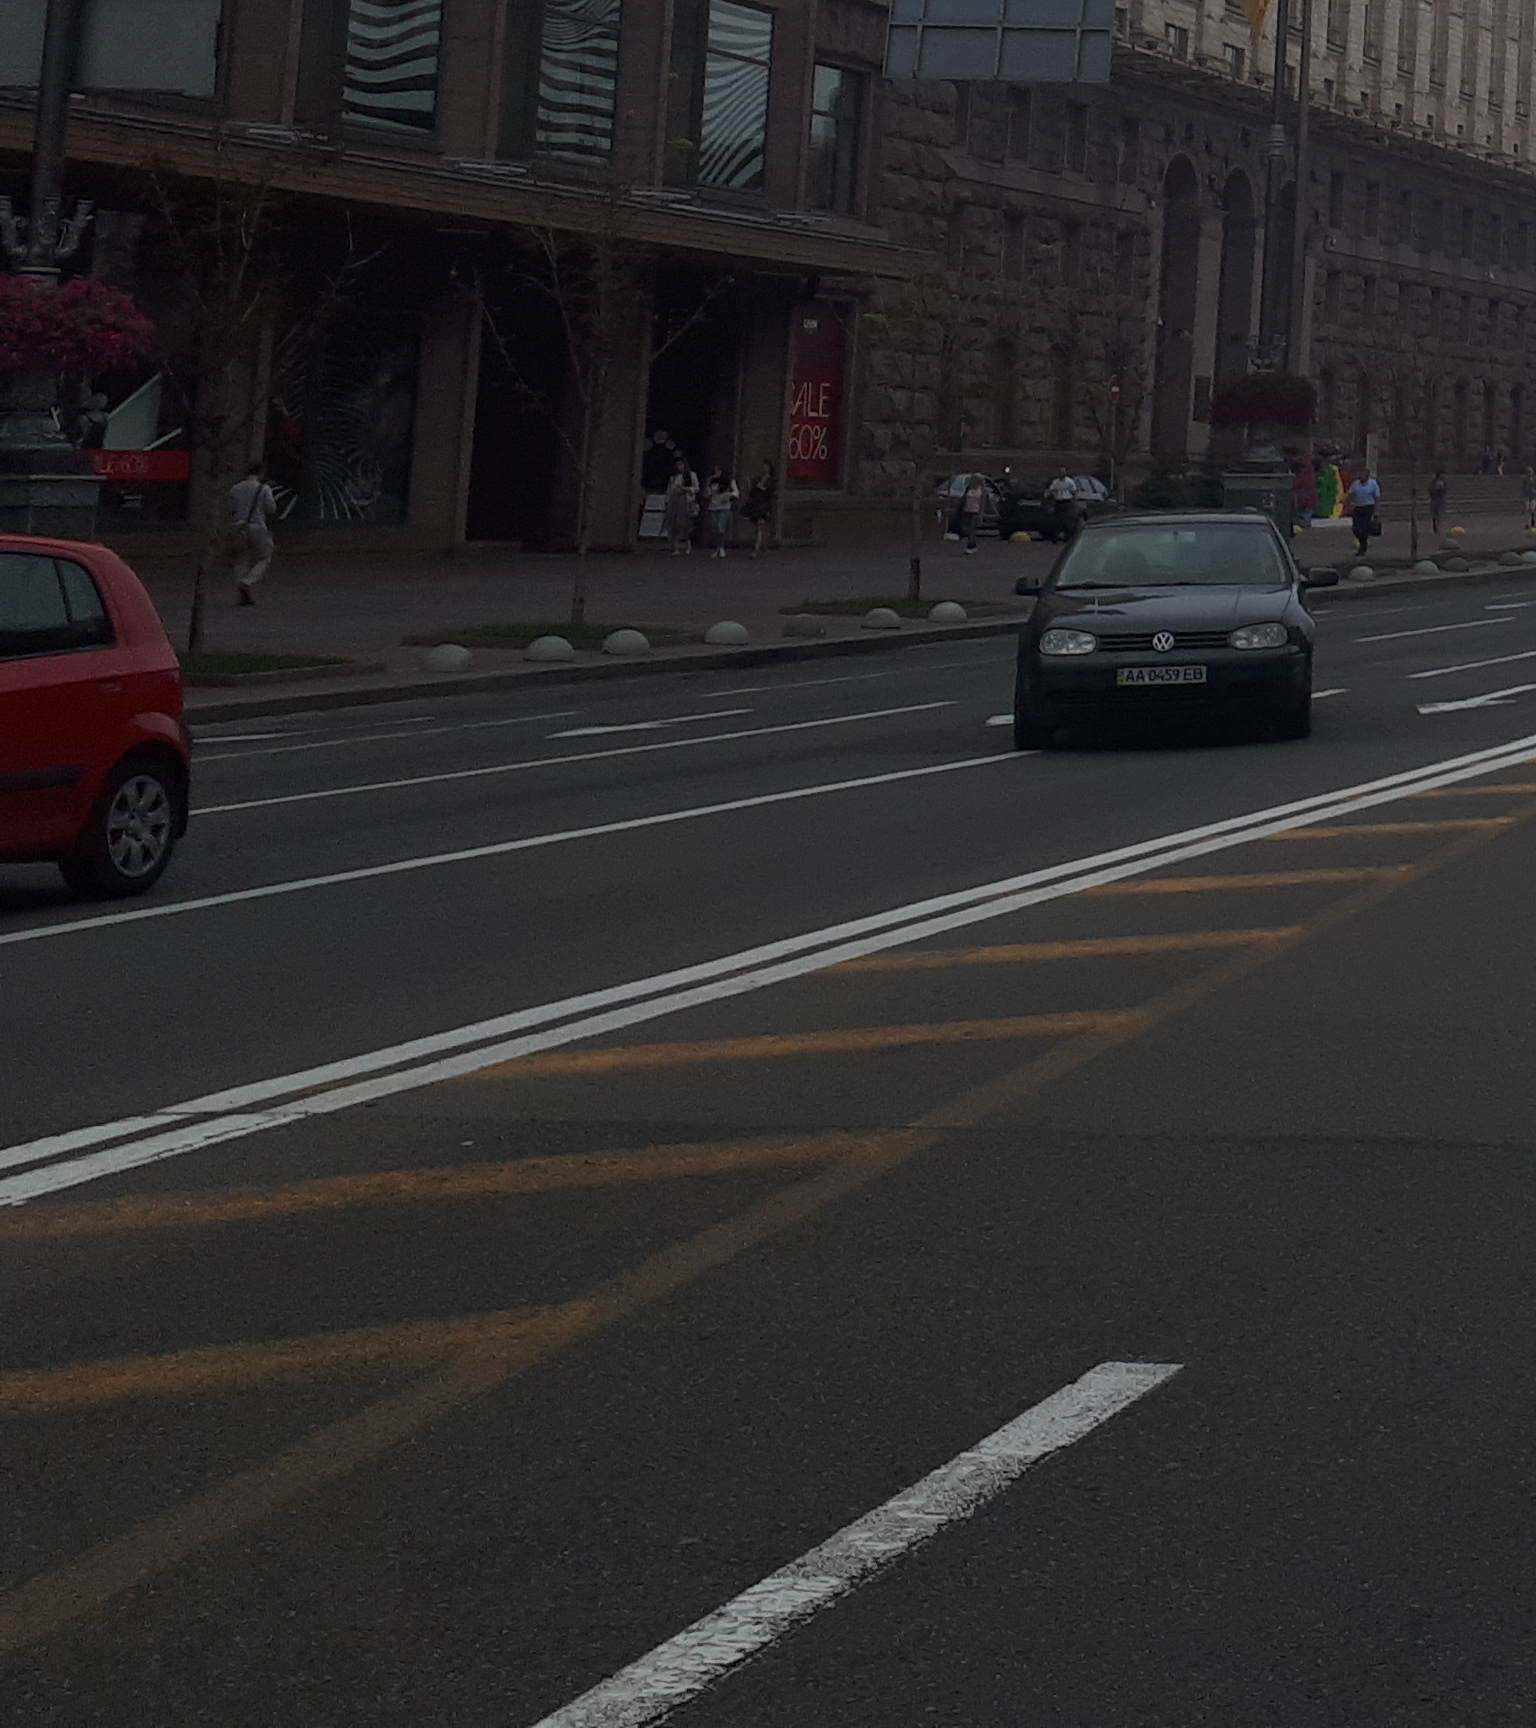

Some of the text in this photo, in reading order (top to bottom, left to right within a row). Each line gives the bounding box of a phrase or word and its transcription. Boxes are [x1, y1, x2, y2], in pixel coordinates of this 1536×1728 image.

[791, 381, 831, 418] ALE
[788, 423, 828, 460] 60%
[1126, 669, 1145, 683] AA
[1148, 668, 1180, 682] 0459
